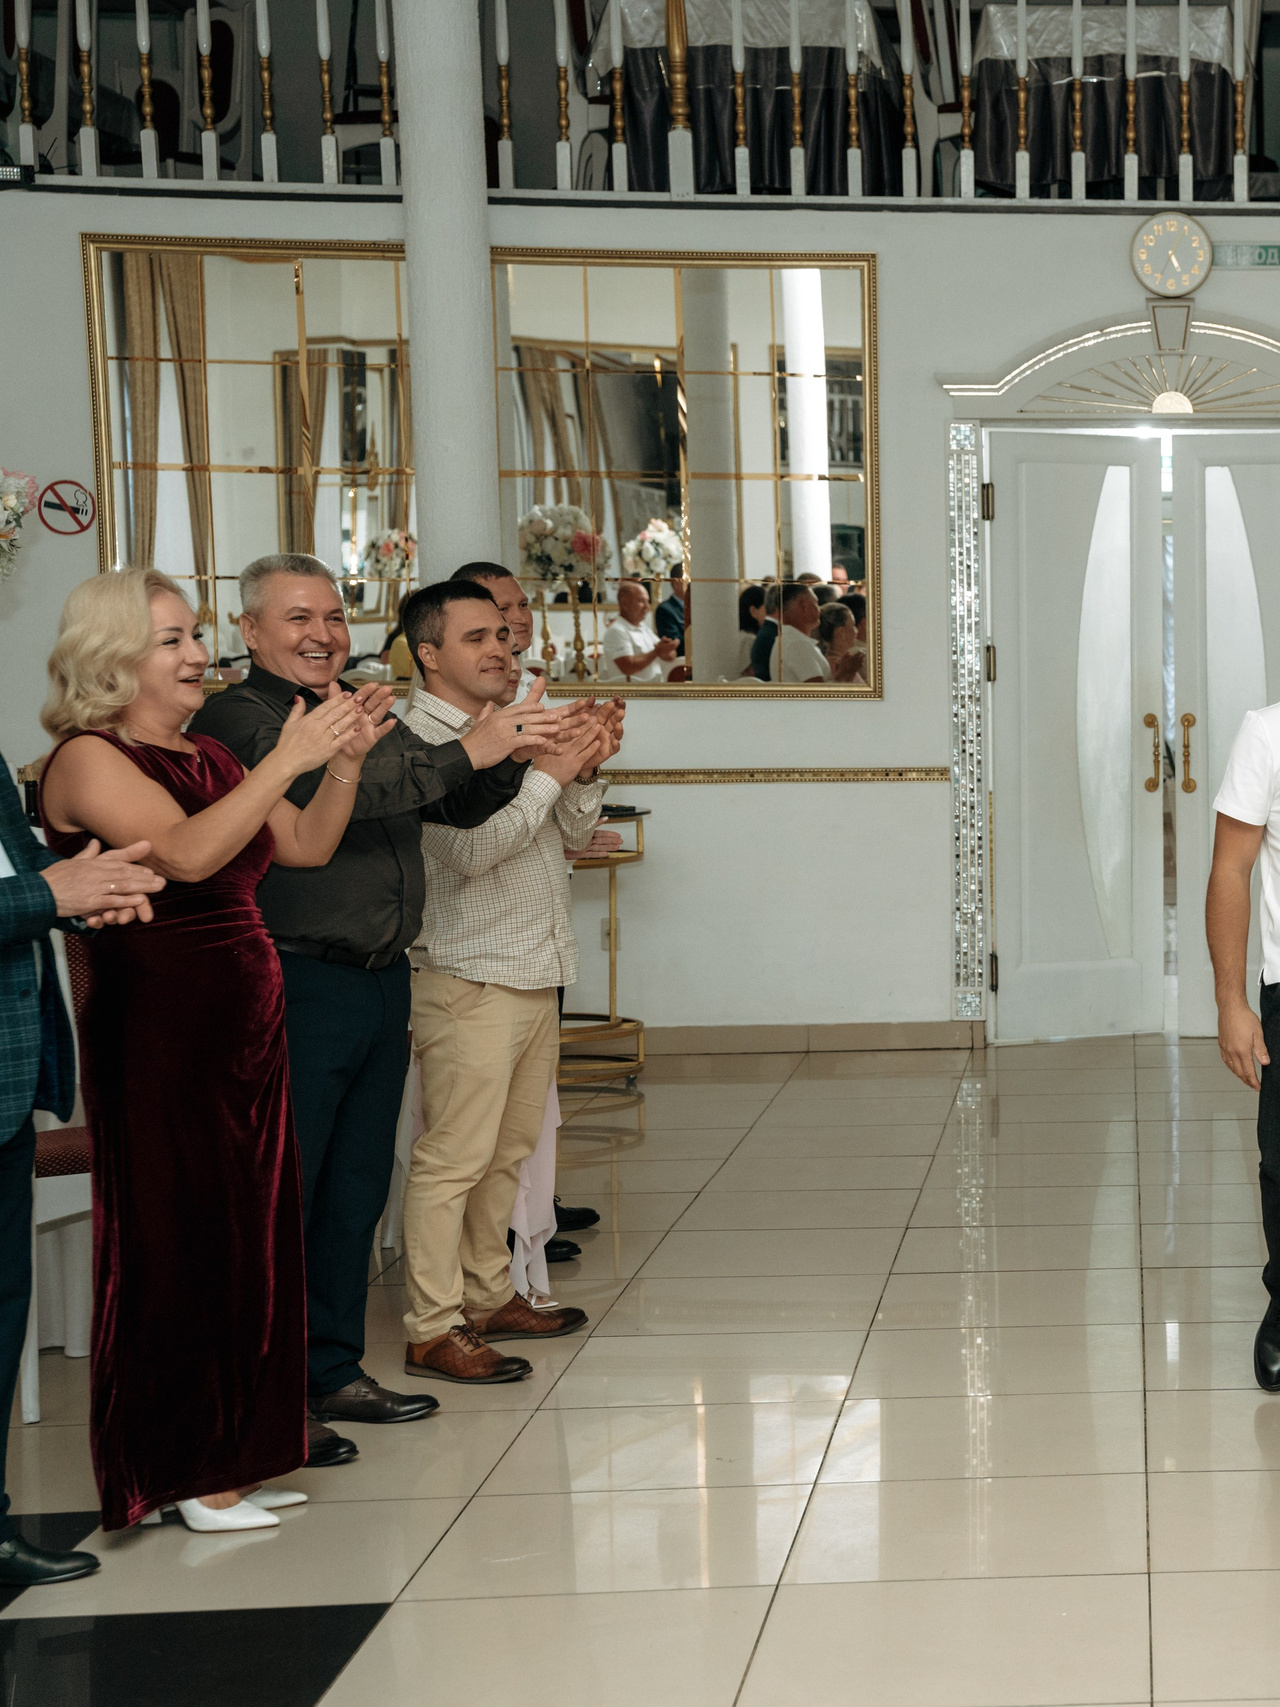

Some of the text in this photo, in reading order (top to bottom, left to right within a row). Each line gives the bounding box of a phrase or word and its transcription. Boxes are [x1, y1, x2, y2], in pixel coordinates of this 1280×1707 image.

[1153, 225, 1163, 236] 11
[1166, 220, 1178, 231] 12
[1184, 225, 1189, 236] 1
[1143, 235, 1155, 247] 10
[1191, 236, 1199, 248] 2
[1138, 249, 1147, 260] 9
[1196, 250, 1204, 261] 3
[1143, 263, 1152, 275] 8
[1191, 265, 1199, 275] 4
[1154, 273, 1163, 285] 7
[1166, 278, 1176, 290] 6
[1181, 274, 1190, 286] 5
